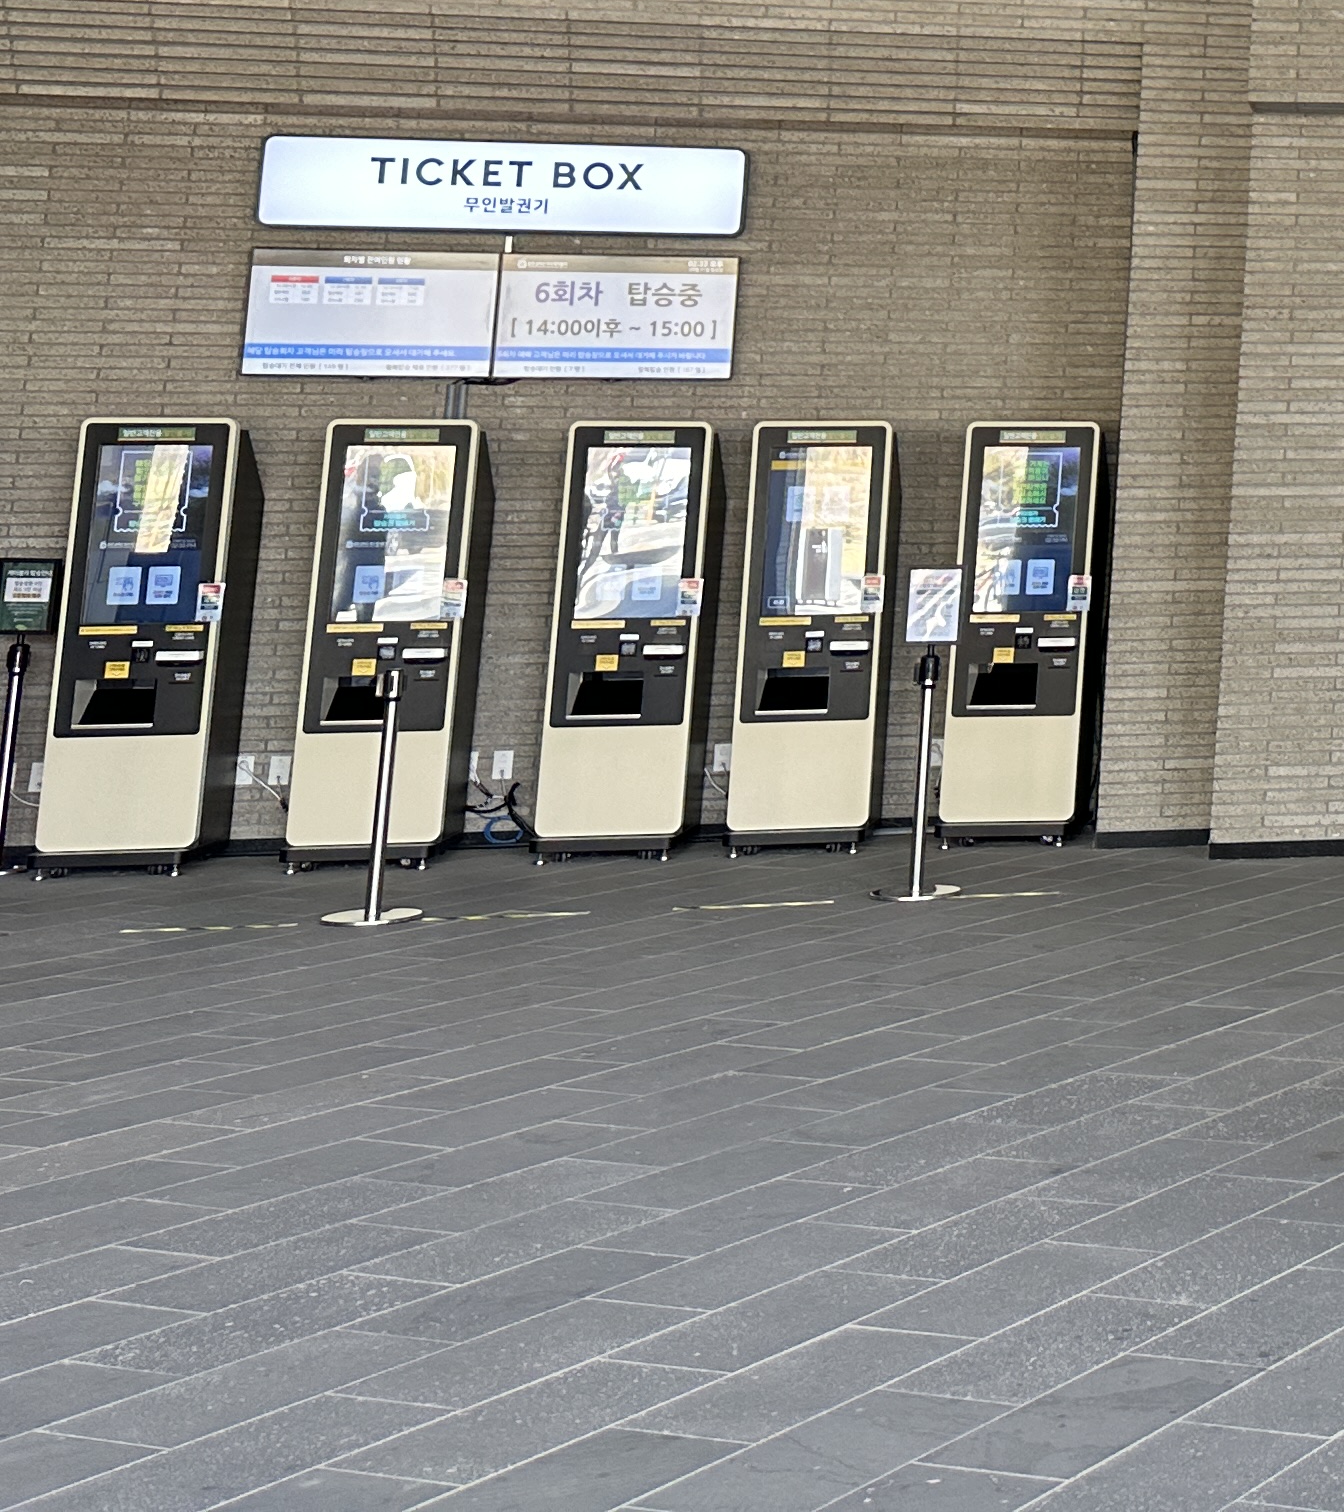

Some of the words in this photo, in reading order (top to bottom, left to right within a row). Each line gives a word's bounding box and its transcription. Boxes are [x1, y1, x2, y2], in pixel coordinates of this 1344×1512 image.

[371, 156, 533, 188] TICKET
[553, 162, 645, 191] BOX
[464, 197, 549, 215] 무인발권기
[535, 280, 604, 307] 6회차
[627, 282, 703, 308] 탑승중
[525, 318, 623, 339] 14:00이후
[650, 320, 705, 337] 15:00
